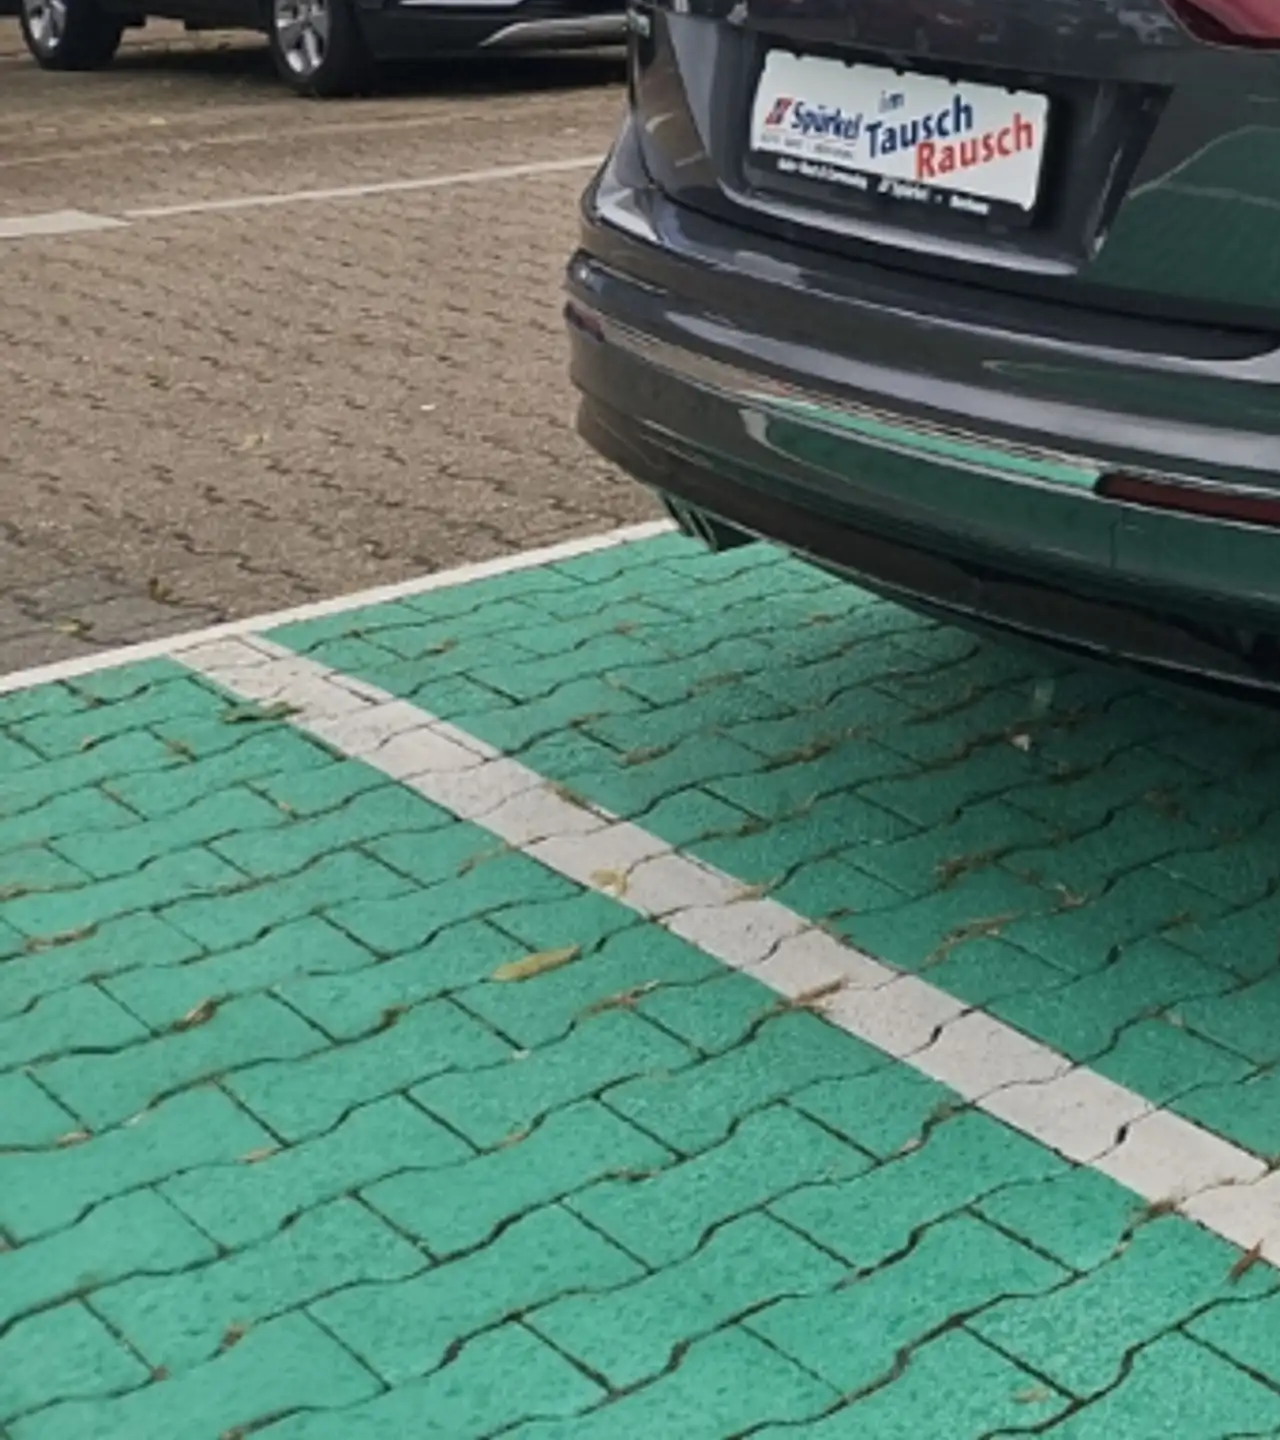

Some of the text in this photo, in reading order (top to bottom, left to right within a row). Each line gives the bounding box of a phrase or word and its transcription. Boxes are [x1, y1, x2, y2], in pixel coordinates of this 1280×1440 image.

[791, 100, 863, 140] Spürkel
[865, 94, 973, 159] Tausch
[879, 90, 905, 113] im
[915, 112, 1033, 181] Rausch
